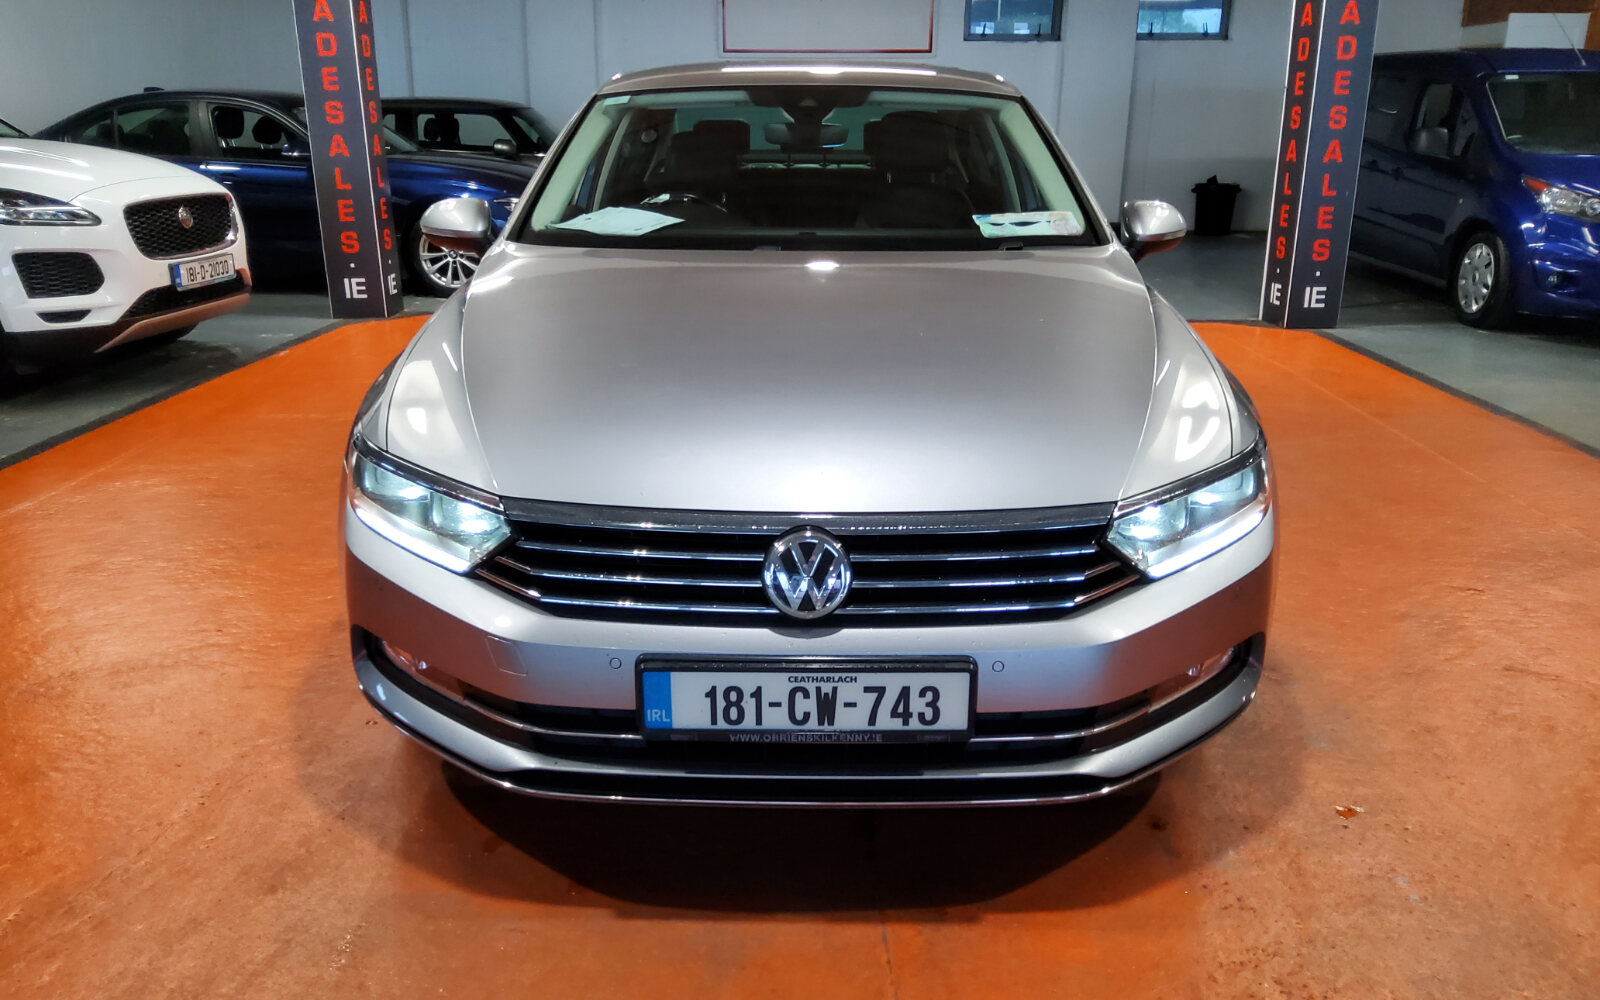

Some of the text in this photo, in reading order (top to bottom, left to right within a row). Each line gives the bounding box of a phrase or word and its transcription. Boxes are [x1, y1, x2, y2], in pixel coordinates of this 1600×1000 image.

[185, 259, 230, 283] 181-D-21030
[788, 675, 858, 684] CEATHARLACH
[704, 685, 942, 727] 181-CW-743
[647, 709, 671, 722] IRL
